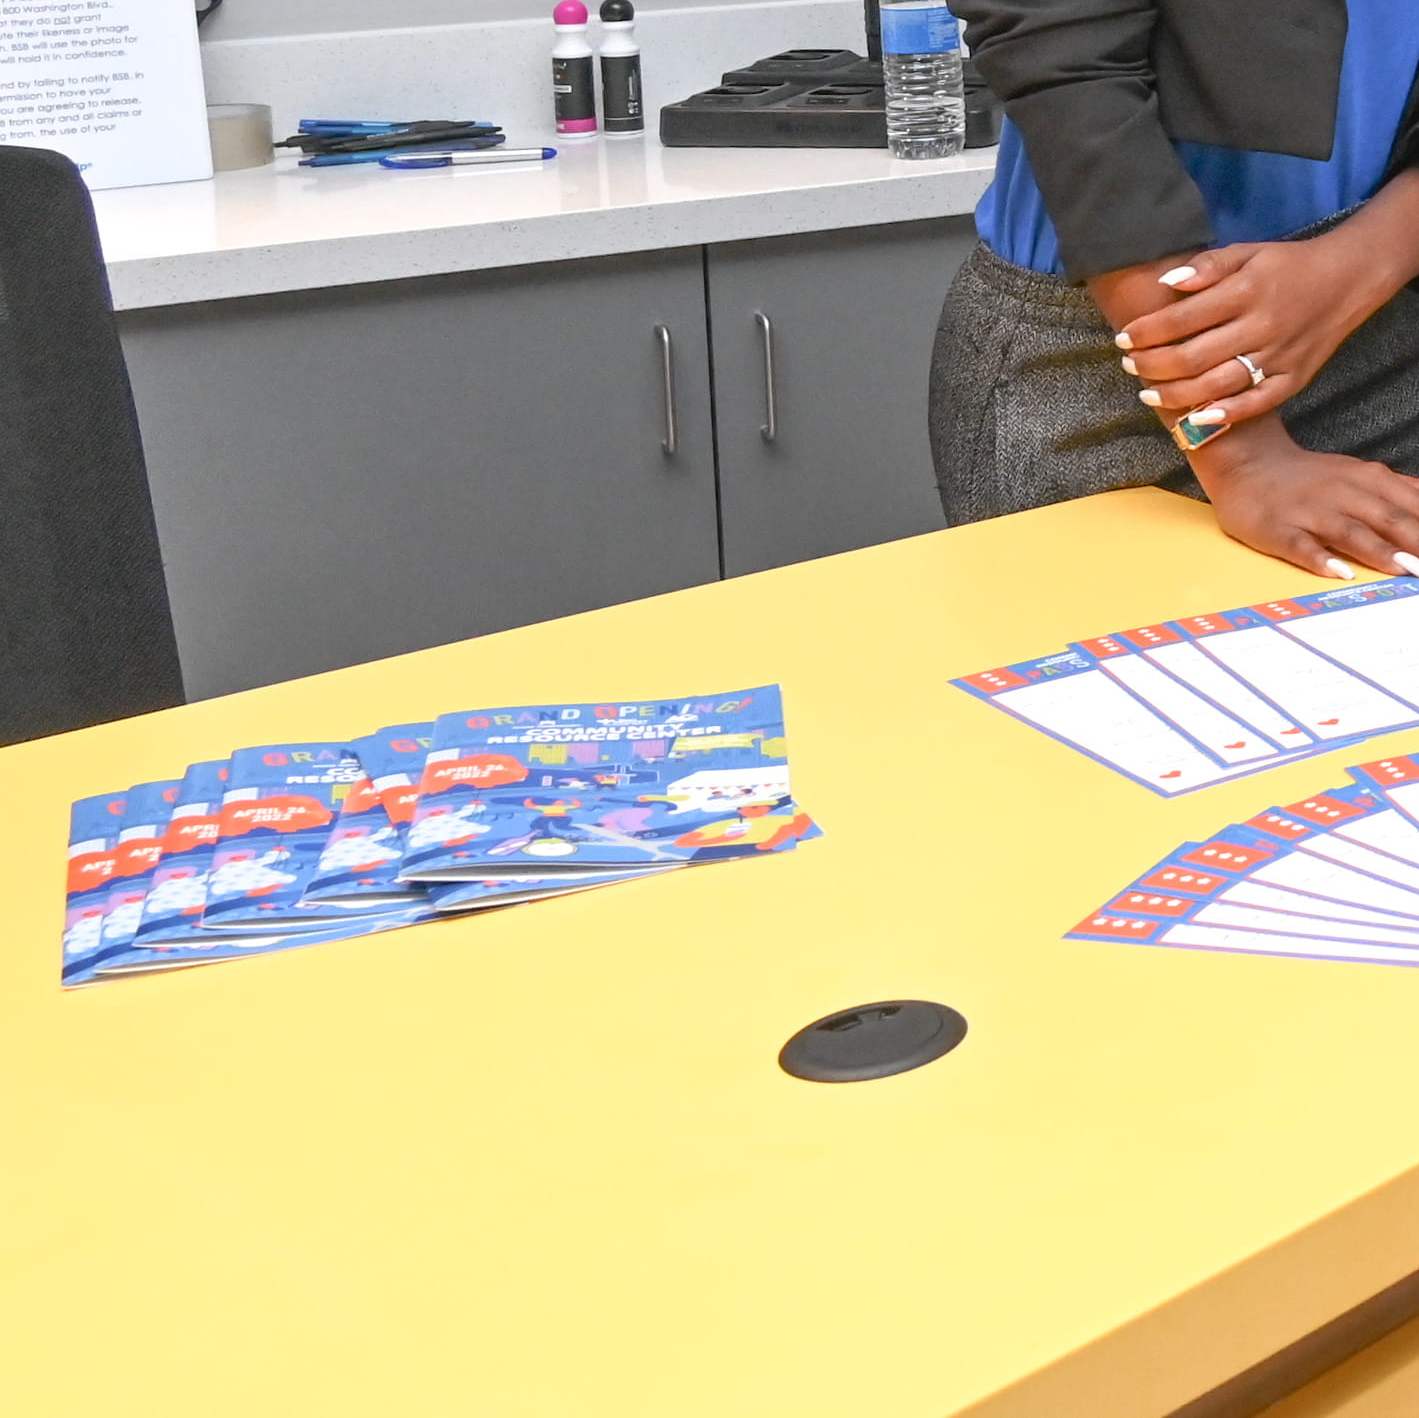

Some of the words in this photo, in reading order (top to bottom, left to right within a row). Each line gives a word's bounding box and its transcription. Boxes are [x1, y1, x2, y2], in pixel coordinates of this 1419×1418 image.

[1308, 583, 1418, 611] PASSPORT
[466, 708, 581, 729] GRAND
[594, 698, 756, 720] OPENING!
[487, 732, 621, 744] RESOURCE
[626, 725, 722, 740] CENTER
[526, 723, 685, 737] COMMUNITY
[434, 765, 479, 778] APRIL
[451, 770, 491, 781] 2022
[233, 807, 280, 819] APRIL
